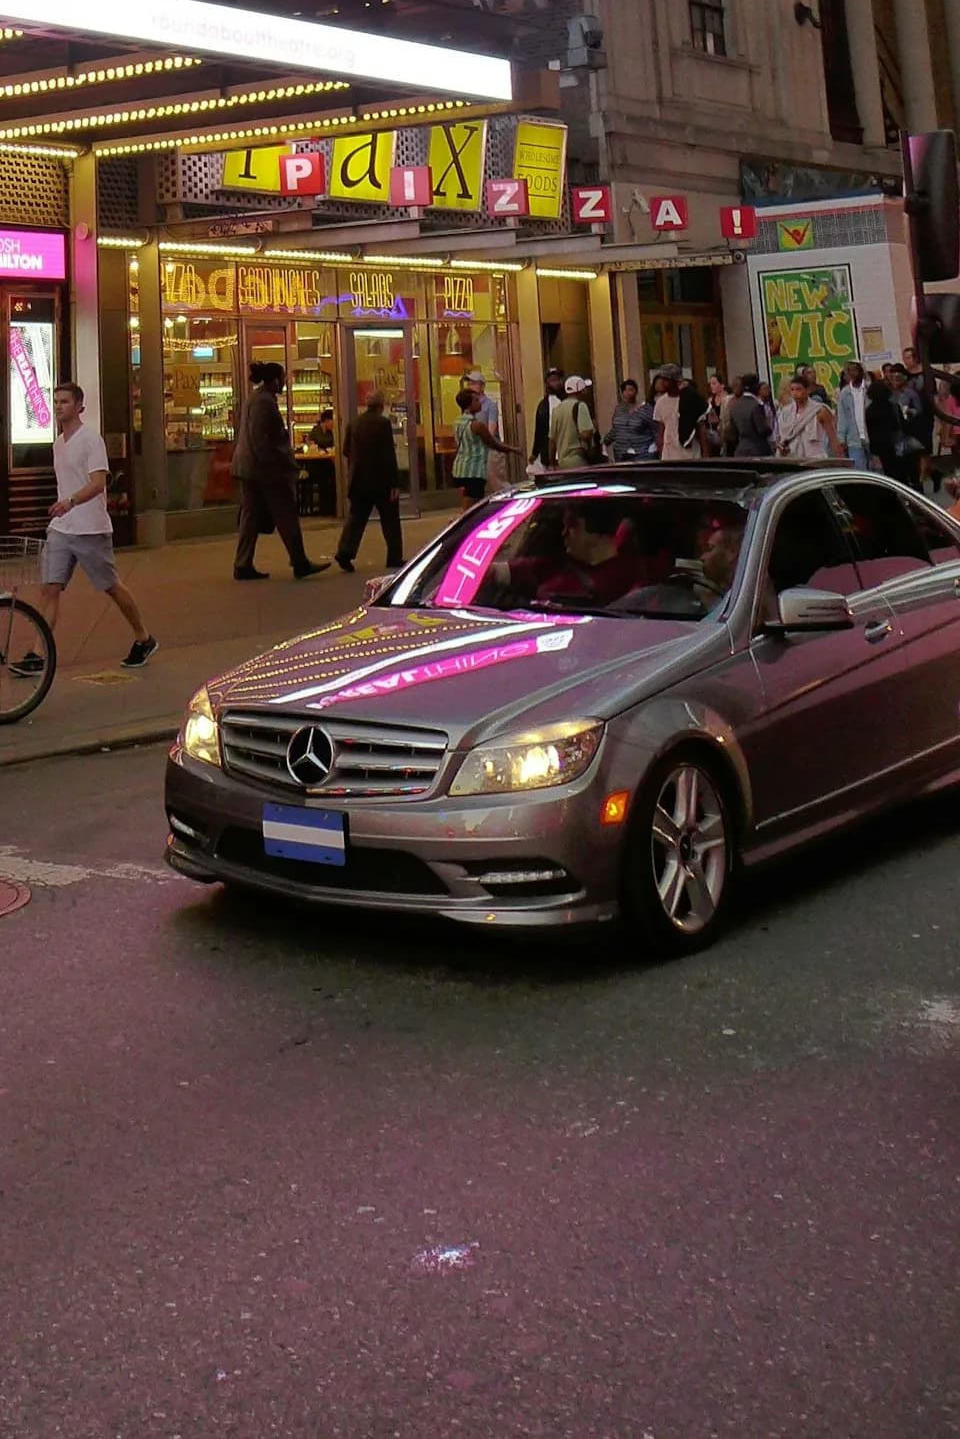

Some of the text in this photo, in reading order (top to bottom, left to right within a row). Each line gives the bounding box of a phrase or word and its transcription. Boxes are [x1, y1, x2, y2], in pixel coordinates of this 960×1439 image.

[518, 174, 558, 193] OODS
[349, 272, 394, 309] SALADS
[444, 276, 474, 312] PIZZA
[764, 277, 829, 313] NEW
[775, 310, 852, 359] VIC
